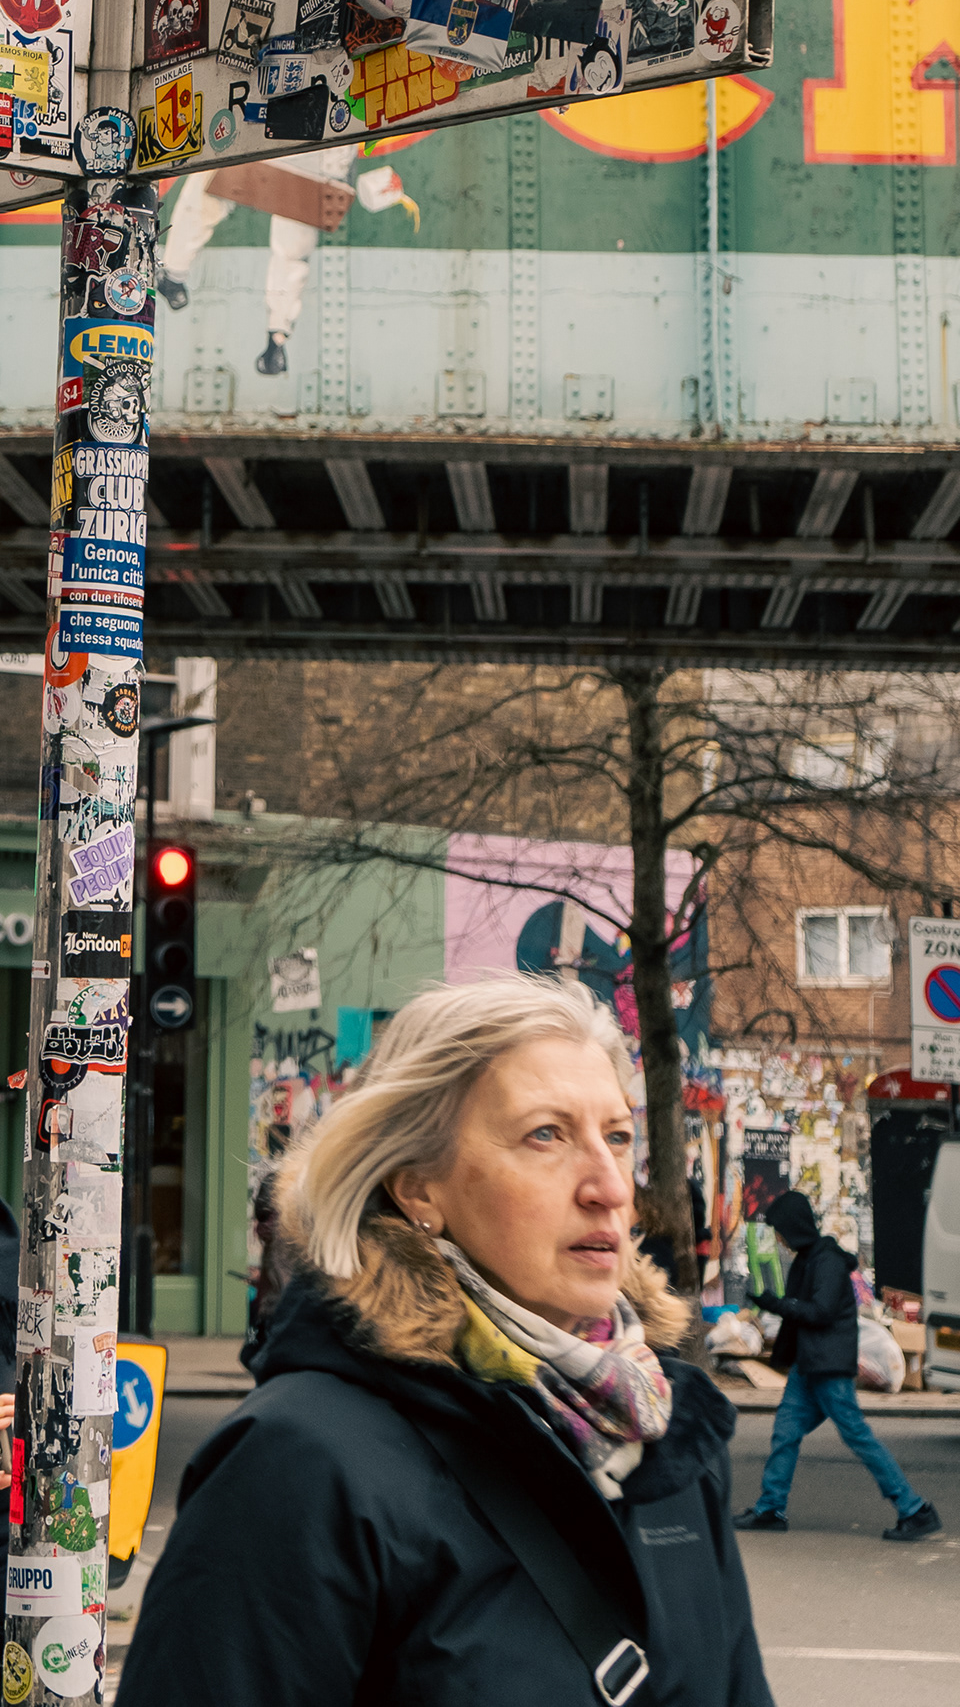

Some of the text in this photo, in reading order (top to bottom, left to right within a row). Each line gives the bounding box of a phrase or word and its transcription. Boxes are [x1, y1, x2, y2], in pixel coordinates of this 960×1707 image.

[22, 50, 43, 61] RIOJA
[218, 54, 255, 73] DOMING
[154, 62, 193, 86] DINKLAGE
[349, 41, 434, 97] LENS
[365, 66, 456, 129] FANS
[214, 123, 226, 140] EF
[50, 146, 71, 157] PARTY
[91, 363, 143, 420] LONDON GHOSTS
[55, 451, 72, 478] CLU
[90, 475, 144, 512] CLUB
[79, 502, 147, 548] ZÜRIC
[84, 543, 141, 568] Genova,
[71, 563, 144, 587] l'unica città
[69, 590, 143, 609] con due tifoserie
[70, 613, 140, 633] che seguono
[62, 630, 72, 643] la
[74, 632, 112, 646] stessa
[74, 825, 133, 875] EQUIPO
[65, 932, 121, 956] London
[83, 932, 99, 940] New
[9, 1568, 53, 1590] GRUPPO
